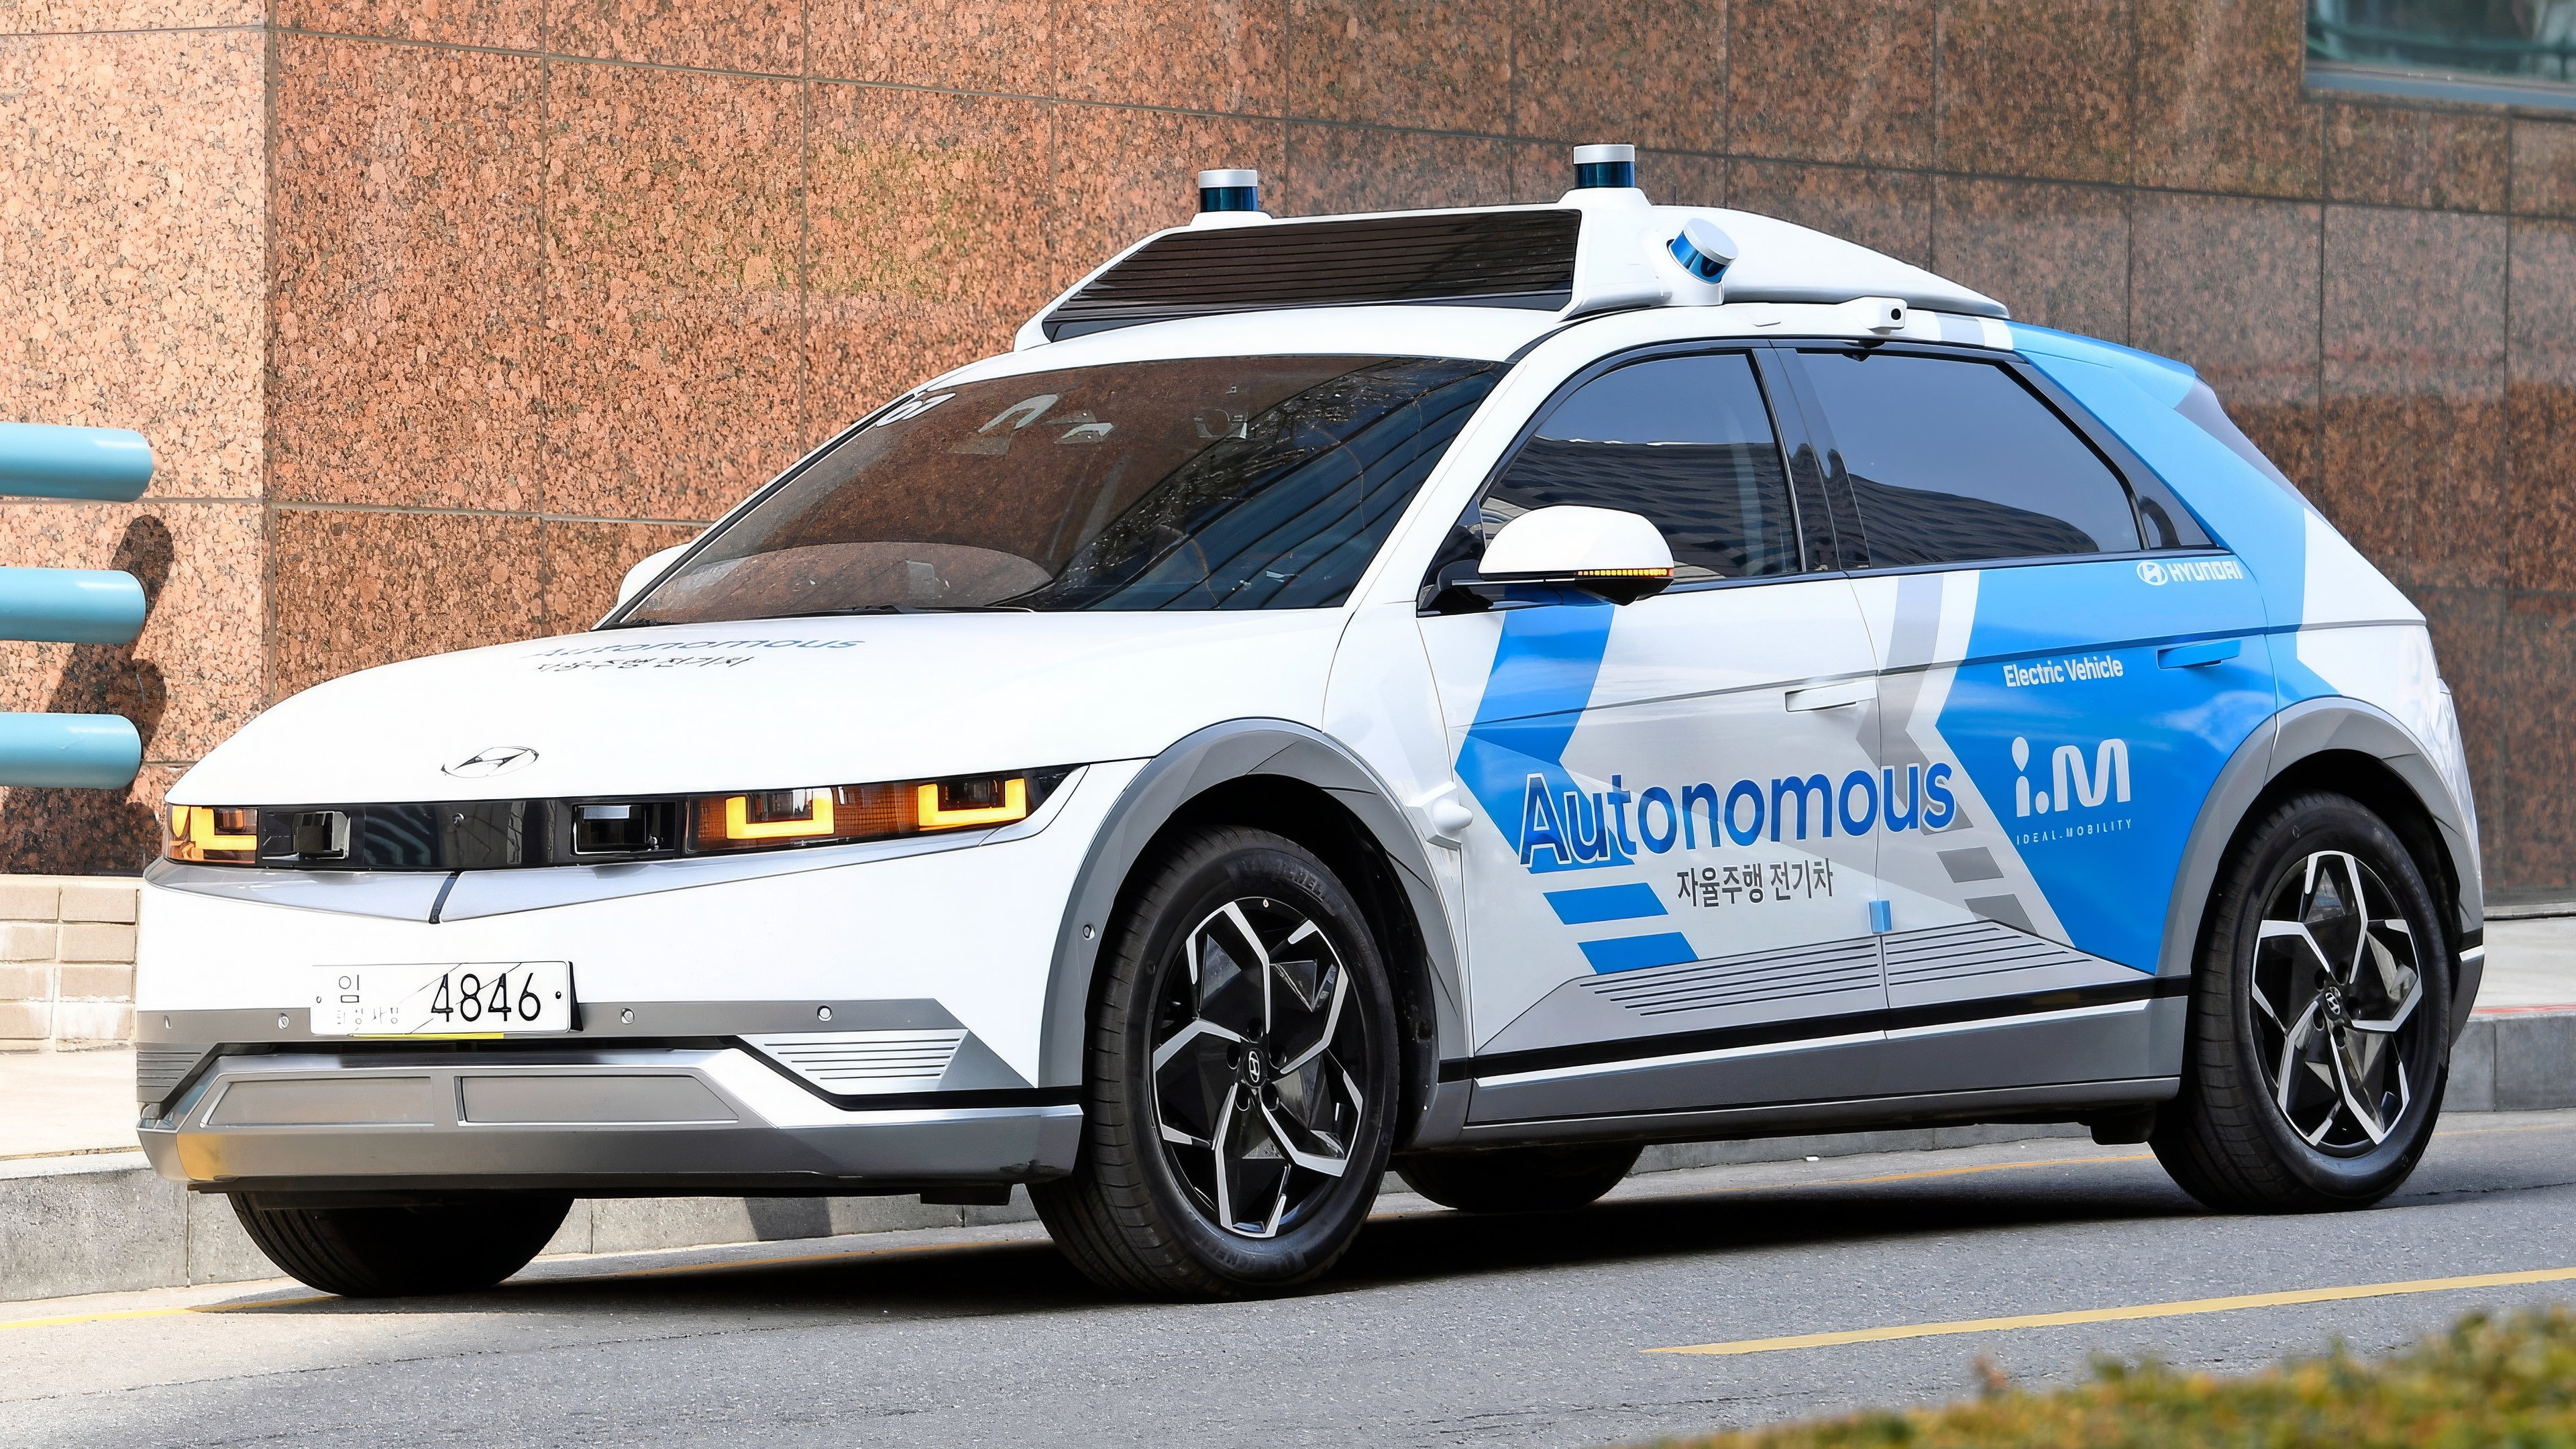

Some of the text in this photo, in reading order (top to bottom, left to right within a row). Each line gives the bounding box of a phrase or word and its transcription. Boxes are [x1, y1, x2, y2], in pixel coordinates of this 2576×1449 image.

[2168, 561, 2243, 582] HYUNDAI
[2002, 655, 2124, 688] Electric Vehicle
[1519, 761, 1957, 868] Autonomous
[1676, 857, 1833, 908] 자율주행 전기차
[338, 974, 360, 1003] 임
[431, 973, 541, 1022] 4846
